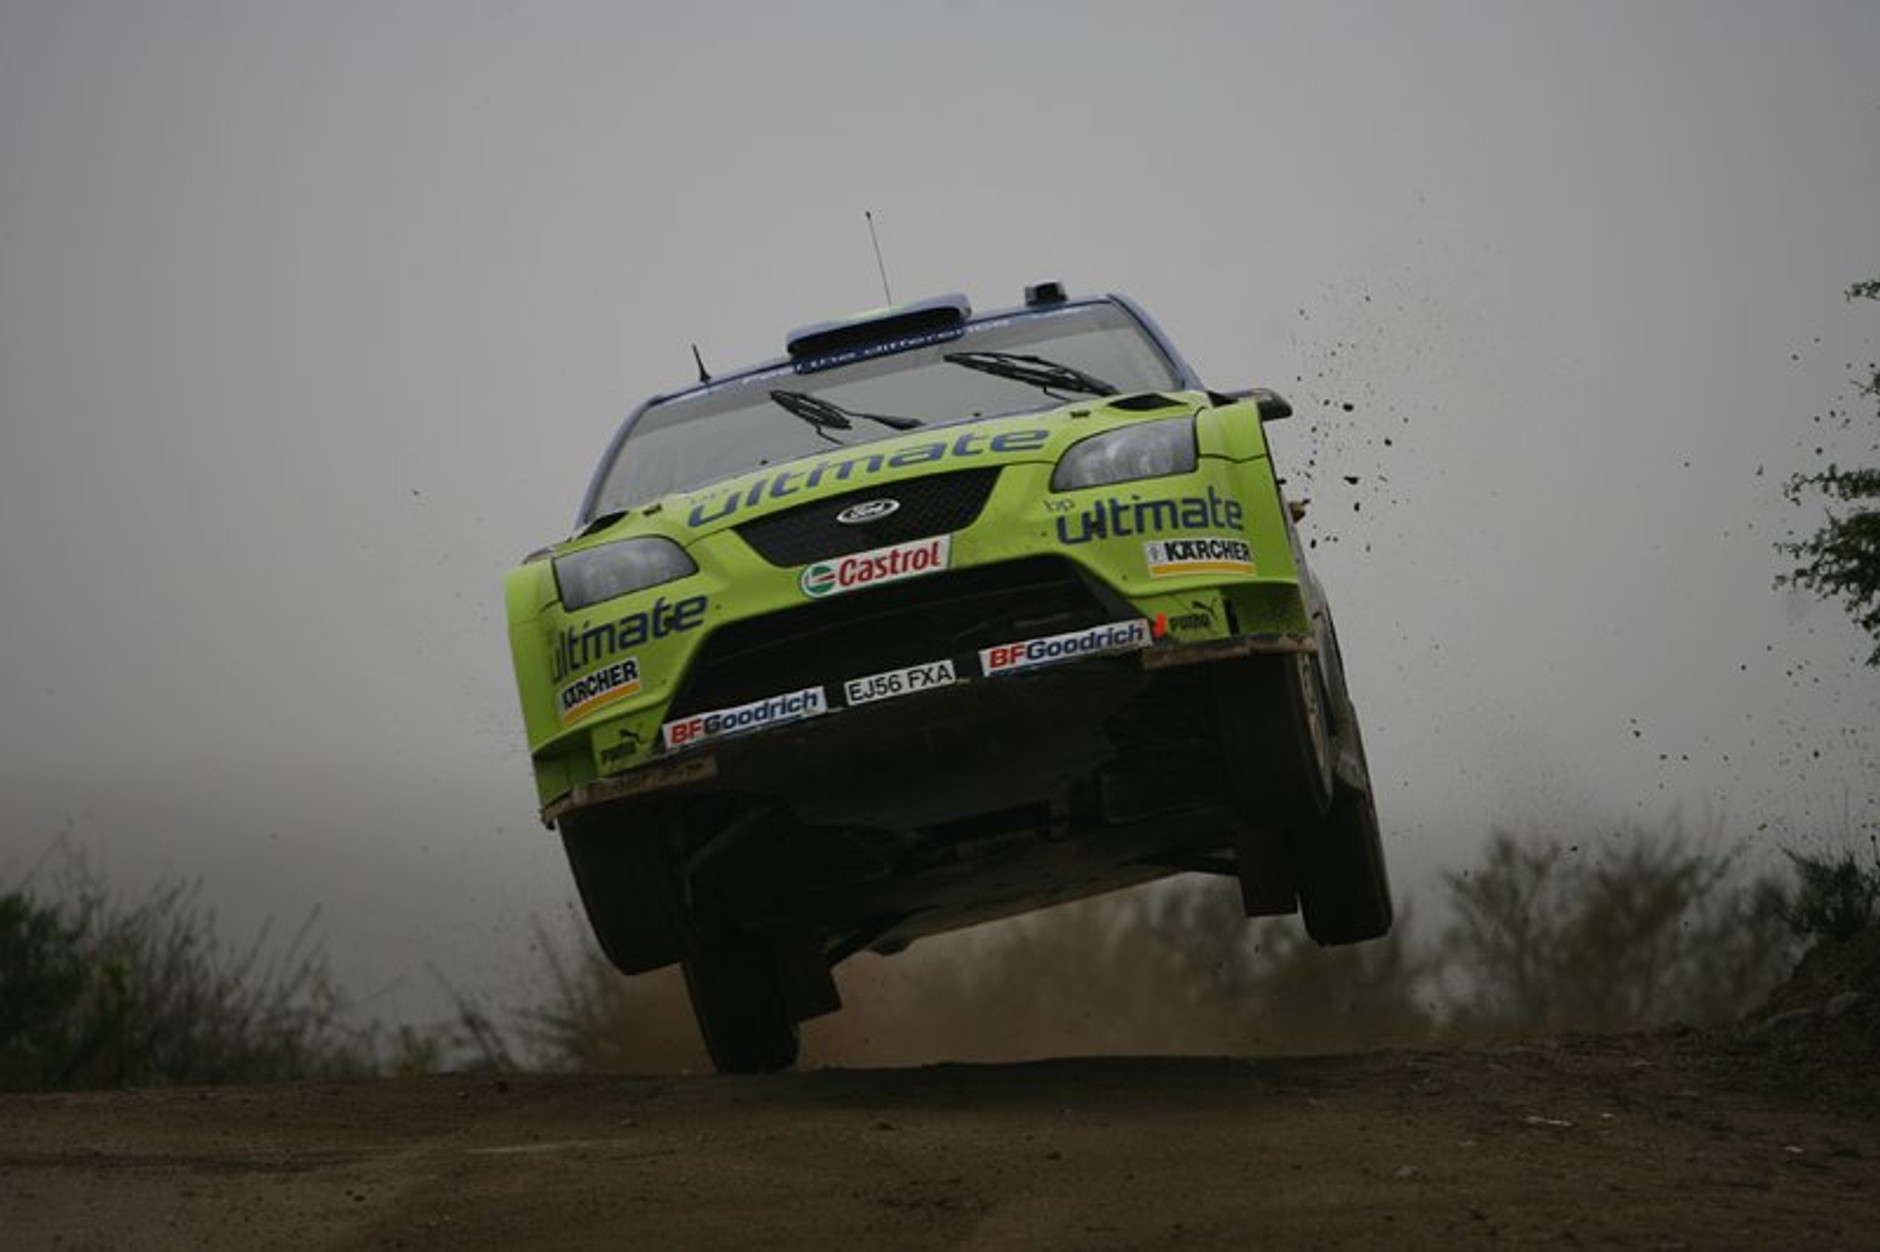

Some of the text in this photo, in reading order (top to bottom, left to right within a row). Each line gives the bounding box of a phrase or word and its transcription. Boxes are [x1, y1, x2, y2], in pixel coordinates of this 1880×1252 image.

[688, 429, 1051, 527] ultimate
[1057, 486, 1244, 544] ultimate
[839, 541, 941, 587] Castrol
[989, 622, 1145, 669] BFGoodrich
[849, 663, 954, 701] EJ56 FXA
[670, 689, 819, 745] BFGoodrich
